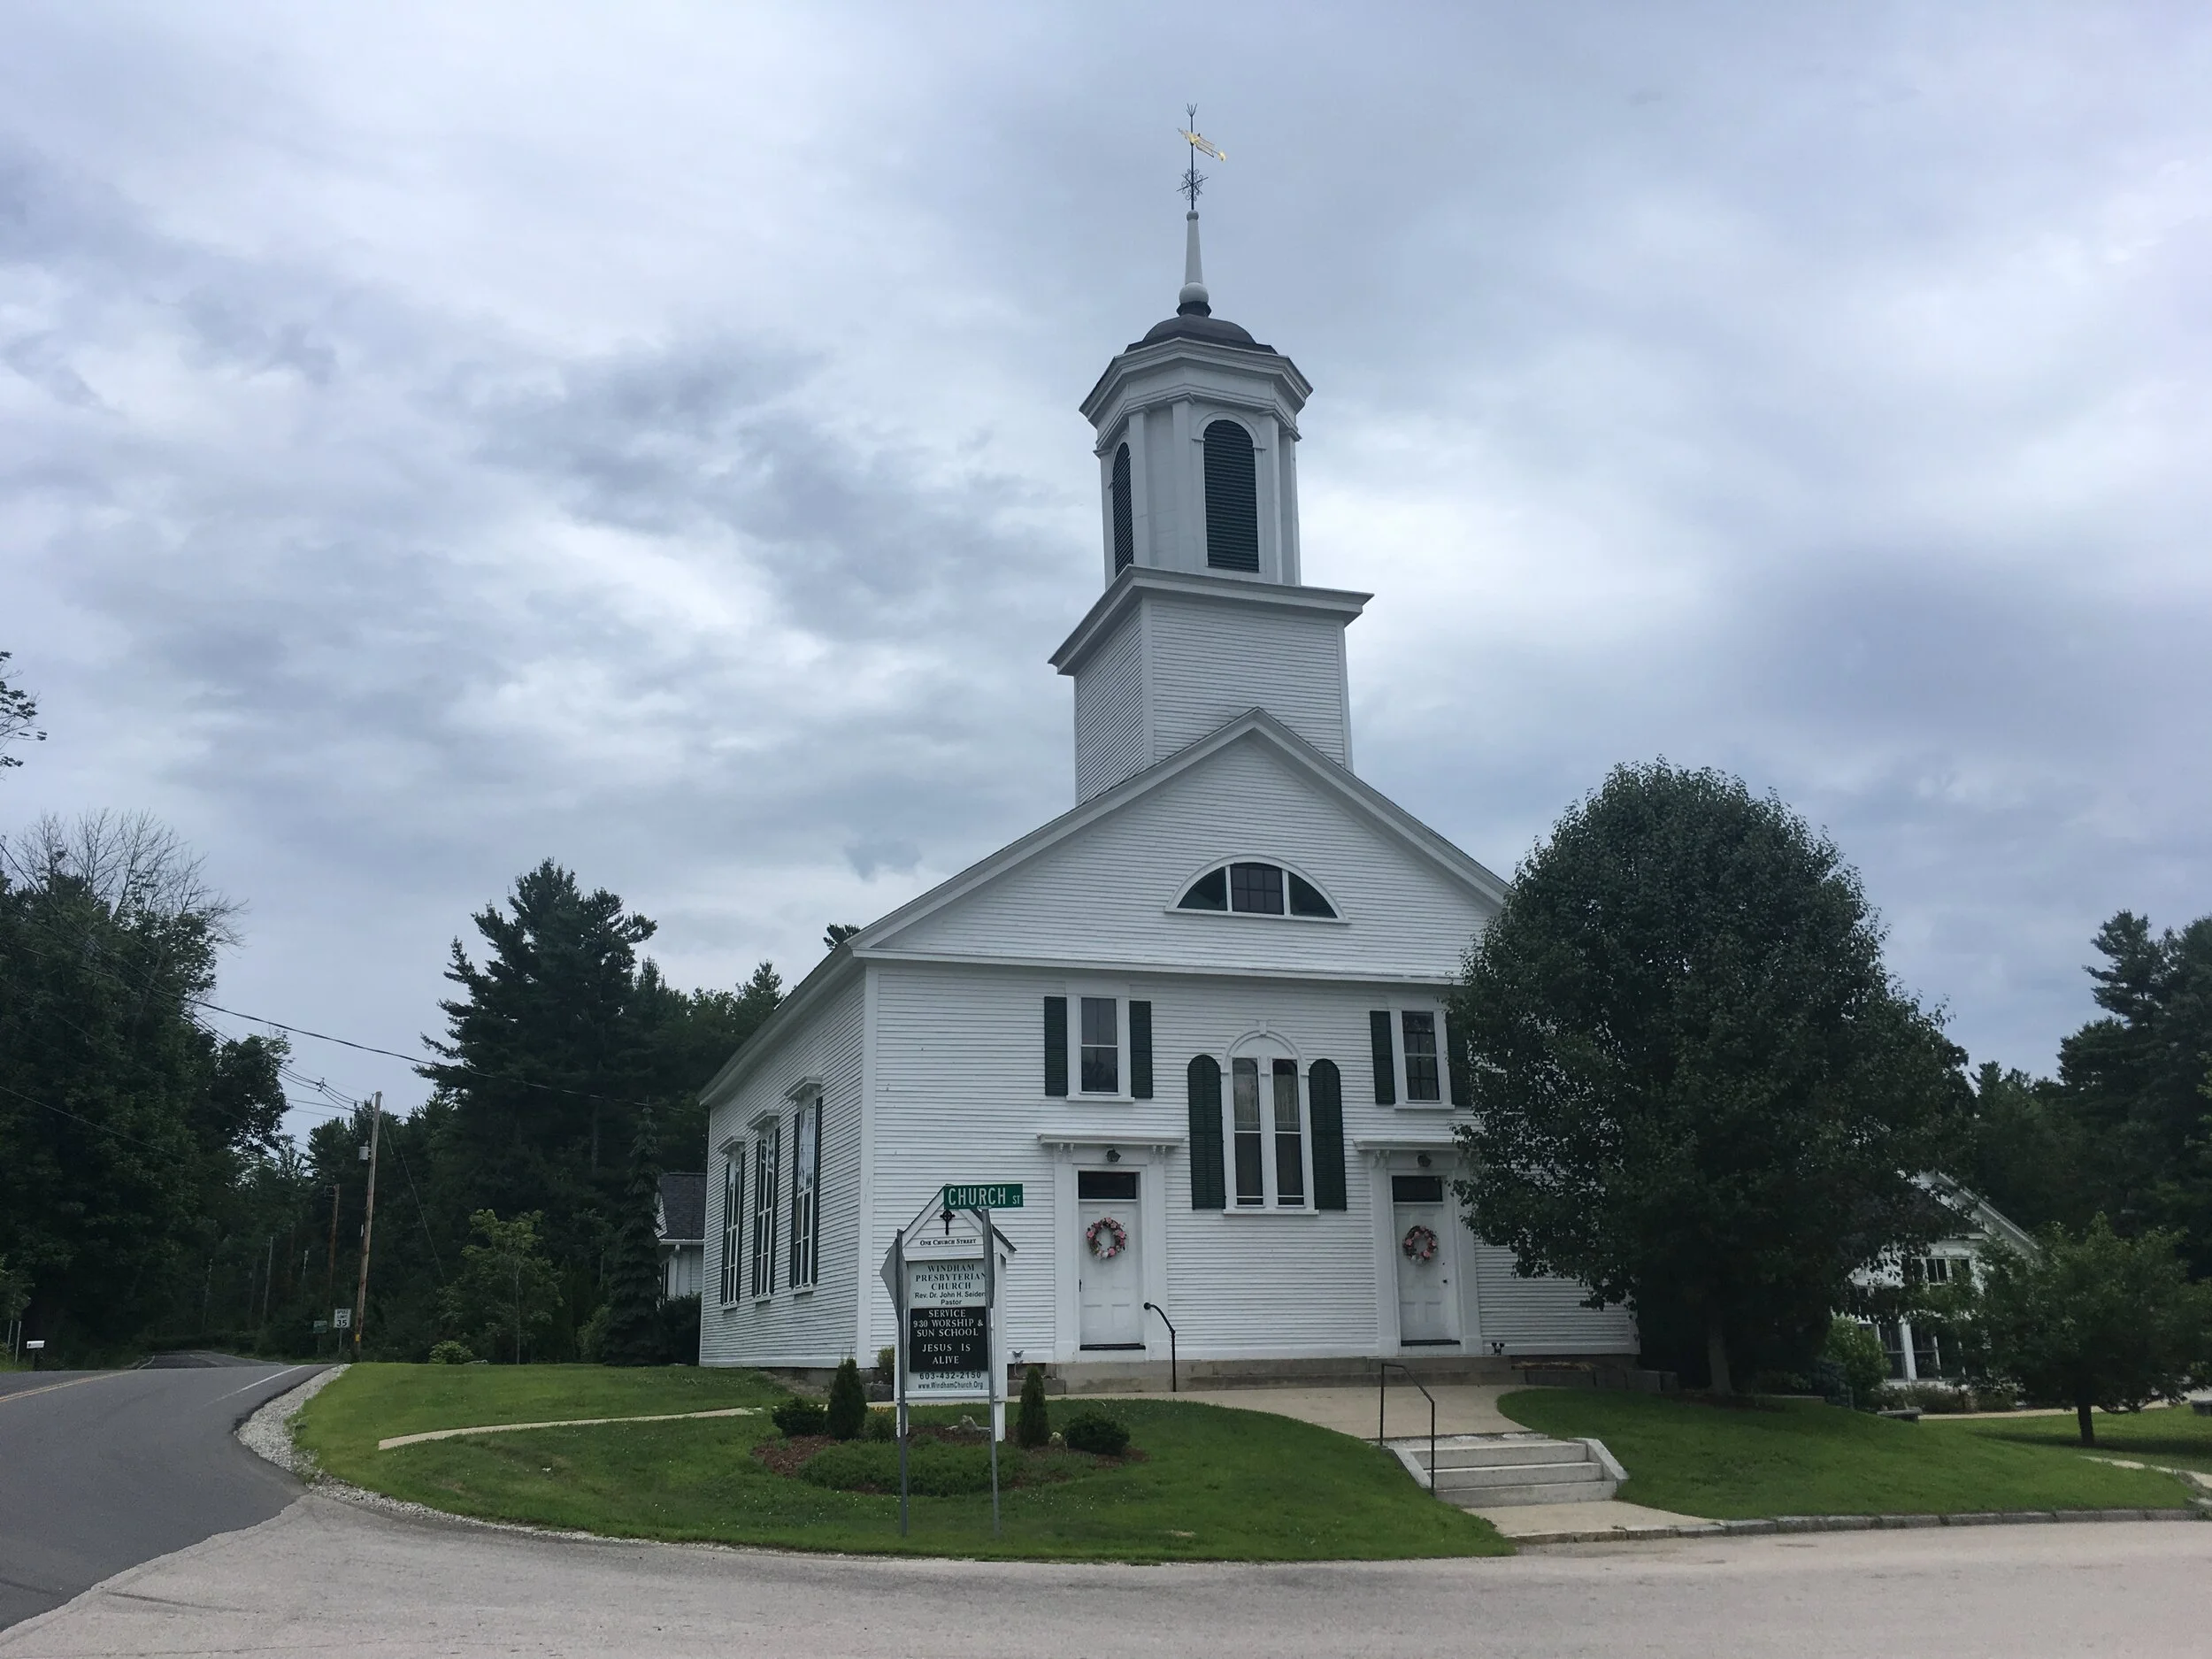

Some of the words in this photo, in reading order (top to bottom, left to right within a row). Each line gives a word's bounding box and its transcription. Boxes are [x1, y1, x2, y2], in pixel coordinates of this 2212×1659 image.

[949, 1187, 1006, 1206] CHURCH
[1012, 1194, 1021, 1205] ST
[927, 1263, 975, 1272] WINDHAM
[931, 1282, 972, 1291] CHURCH
[928, 1309, 966, 1317] SERVICE
[931, 1318, 974, 1327] WORSHIP
[977, 1318, 984, 1327] &
[939, 1327, 979, 1337] SCHOOL
[922, 1343, 952, 1352] JESUS
[961, 1343, 971, 1352] IS
[932, 1356, 960, 1364] ALIVE
[919, 1371, 981, 1379] 603-432-2150
